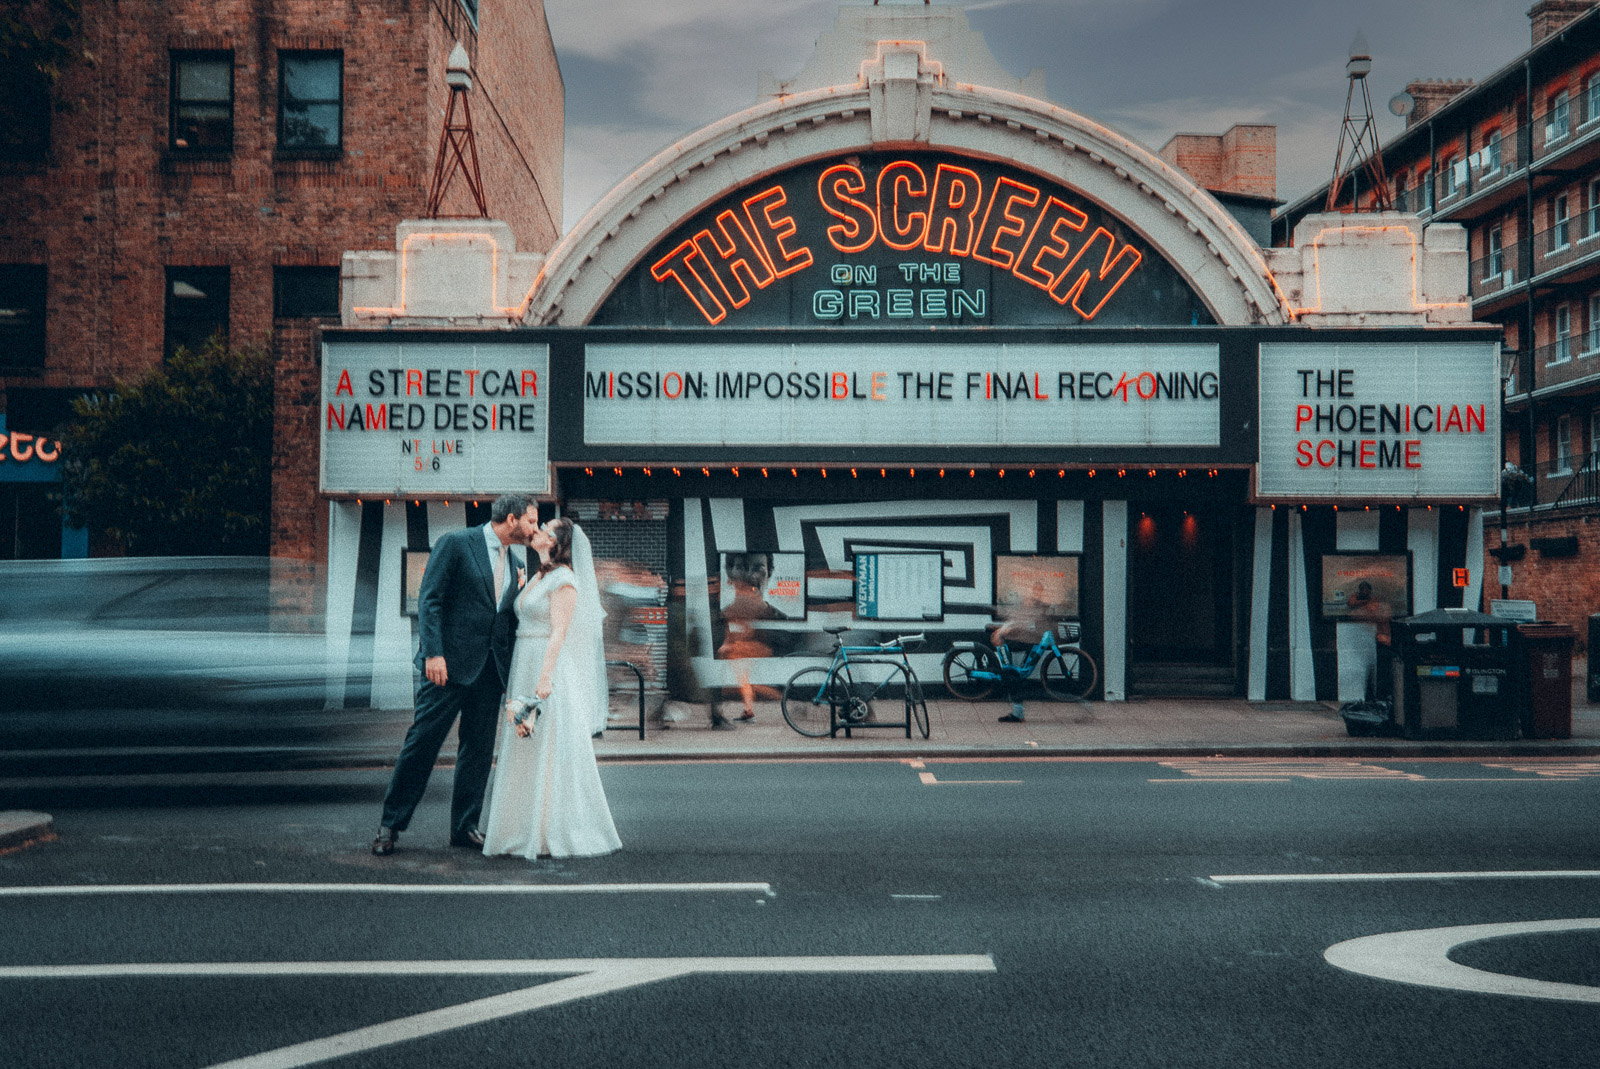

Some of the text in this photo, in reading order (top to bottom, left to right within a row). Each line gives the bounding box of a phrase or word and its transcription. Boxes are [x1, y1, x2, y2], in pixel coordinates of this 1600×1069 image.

[650, 160, 1142, 325] THE SCREEN
[830, 262, 962, 286] ON THE
[813, 288, 986, 320] GREEN
[335, 369, 538, 398] A STREETCAR
[586, 370, 1219, 403] MISSION: IMPOSSIBLE THE FINAL RECKONING
[1297, 369, 1354, 397] THE
[327, 403, 535, 431] NAMED DESIRE
[1295, 404, 1486, 433] PHOENICIAN
[401, 439, 464, 454] NT LIVE
[1295, 439, 1422, 469] SCHEME
[413, 456, 441, 471] 5/6
[858, 555, 868, 616] EVERYMAN
[1455, 569, 1468, 585] H
